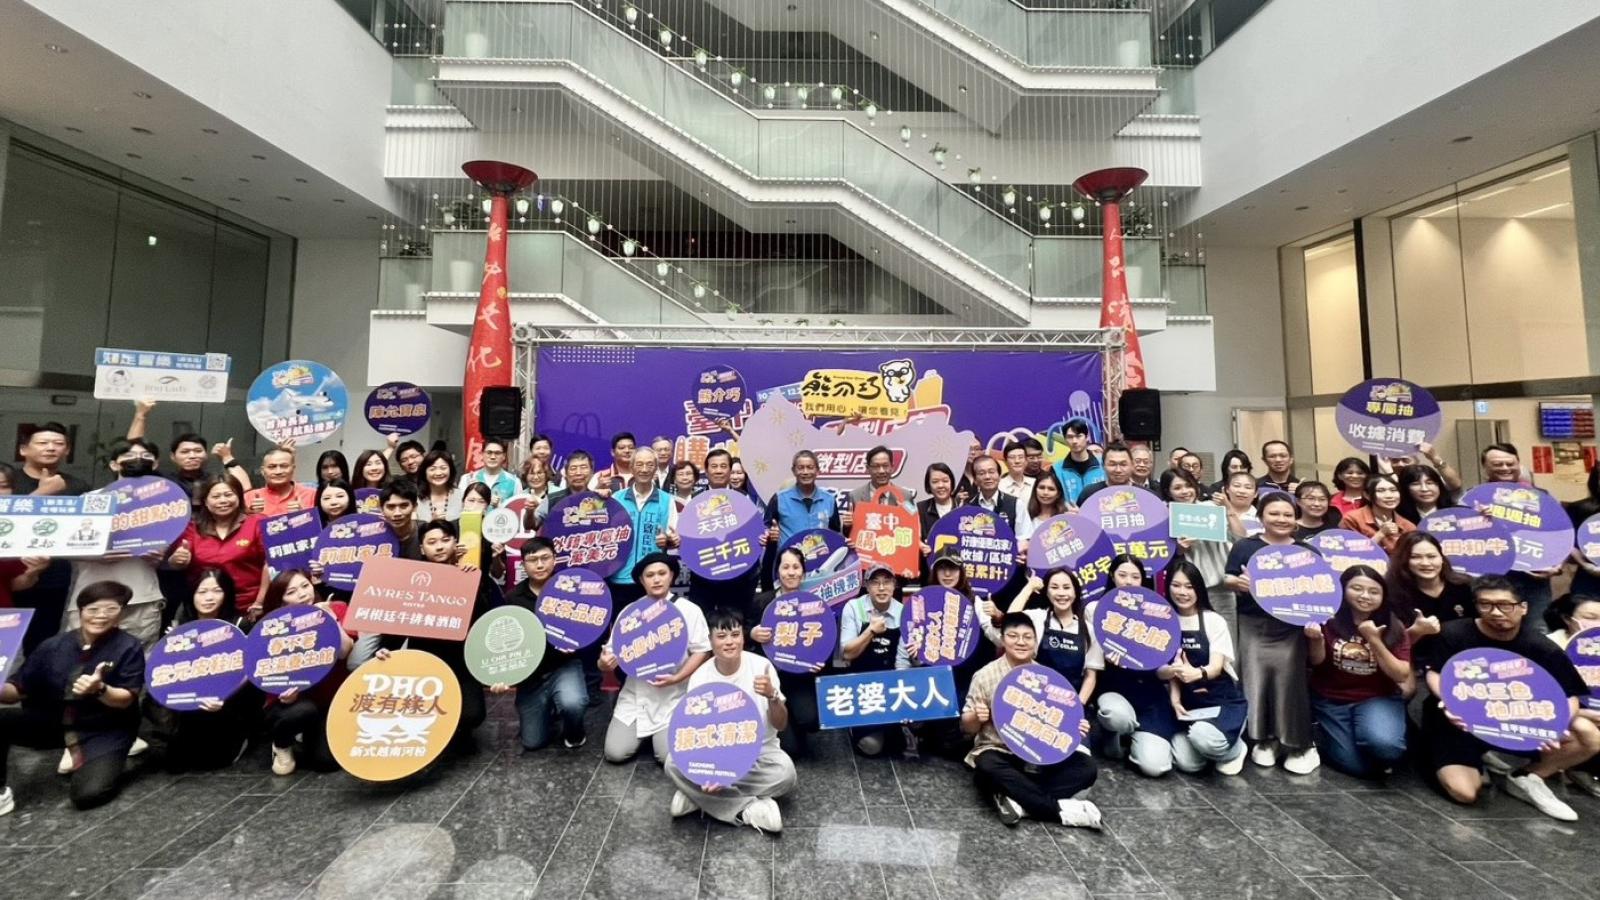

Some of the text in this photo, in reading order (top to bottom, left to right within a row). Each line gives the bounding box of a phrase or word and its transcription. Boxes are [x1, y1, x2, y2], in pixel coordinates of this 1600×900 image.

[1366, 401, 1415, 417] 專屬抽
[1349, 422, 1427, 444] 收據消費
[698, 515, 738, 534] 天天抽
[865, 512, 900, 531] 臺中
[1101, 514, 1145, 528] 月月抽
[555, 544, 618, 567] 一萬美元
[698, 537, 750, 565] 三千元
[364, 586, 467, 607] AYRES TANGO
[355, 607, 462, 630] 阿根廷牛排餐酒館
[773, 621, 823, 646] 梨子
[362, 674, 444, 700] PHO
[826, 676, 949, 717] 老婆大人
[349, 693, 447, 716] 渡有緣人
[350, 745, 427, 758] 新式越南河粉
